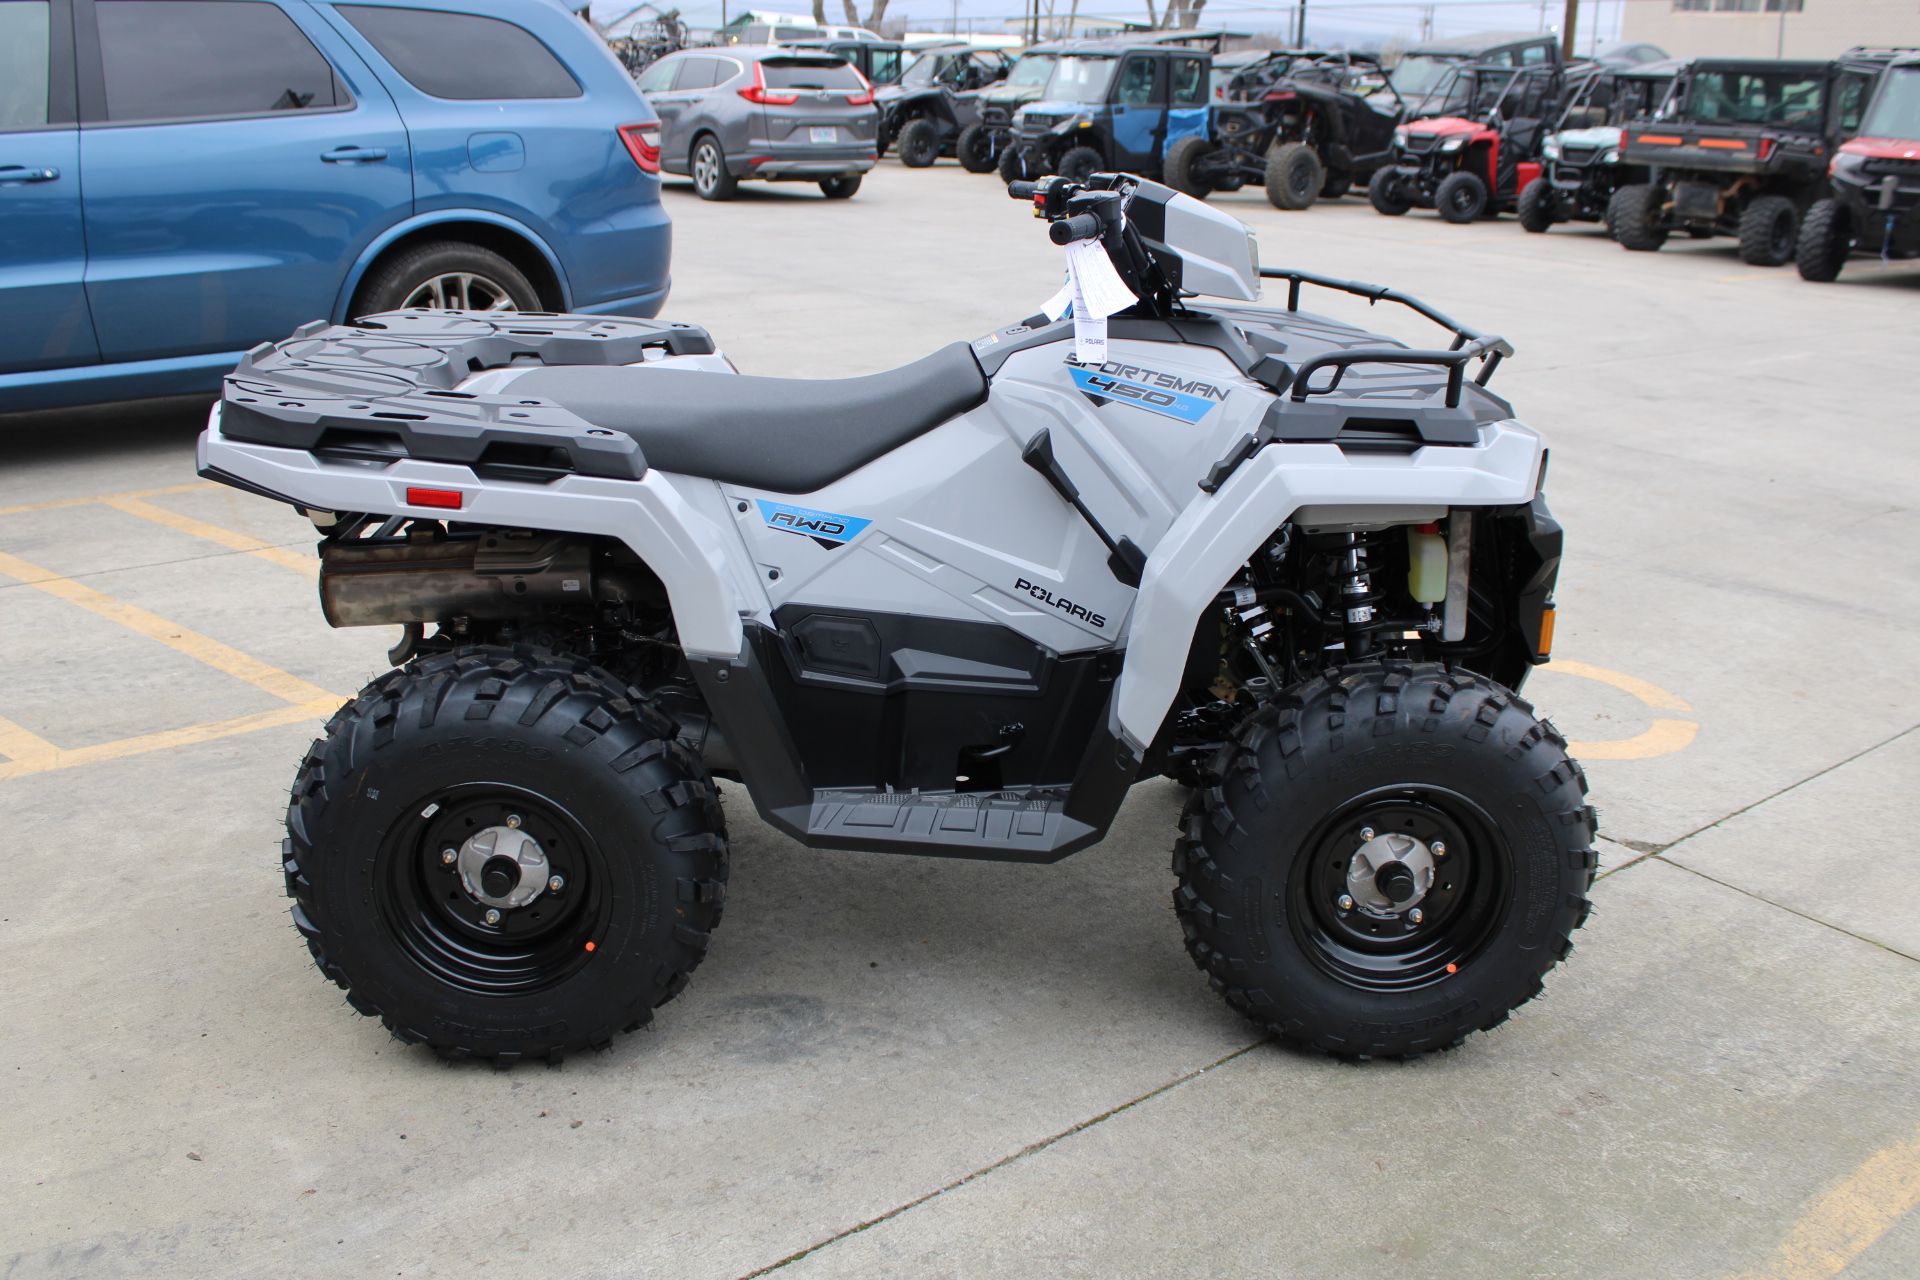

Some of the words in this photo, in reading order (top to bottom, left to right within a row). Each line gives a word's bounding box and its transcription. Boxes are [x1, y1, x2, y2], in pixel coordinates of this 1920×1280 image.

[1085, 338, 1105, 346] POLARIS
[1062, 352, 1231, 401] SORTSMAN
[1087, 376, 1176, 407] 450
[770, 512, 845, 535] AWD
[1014, 577, 1107, 628] POLARIS
